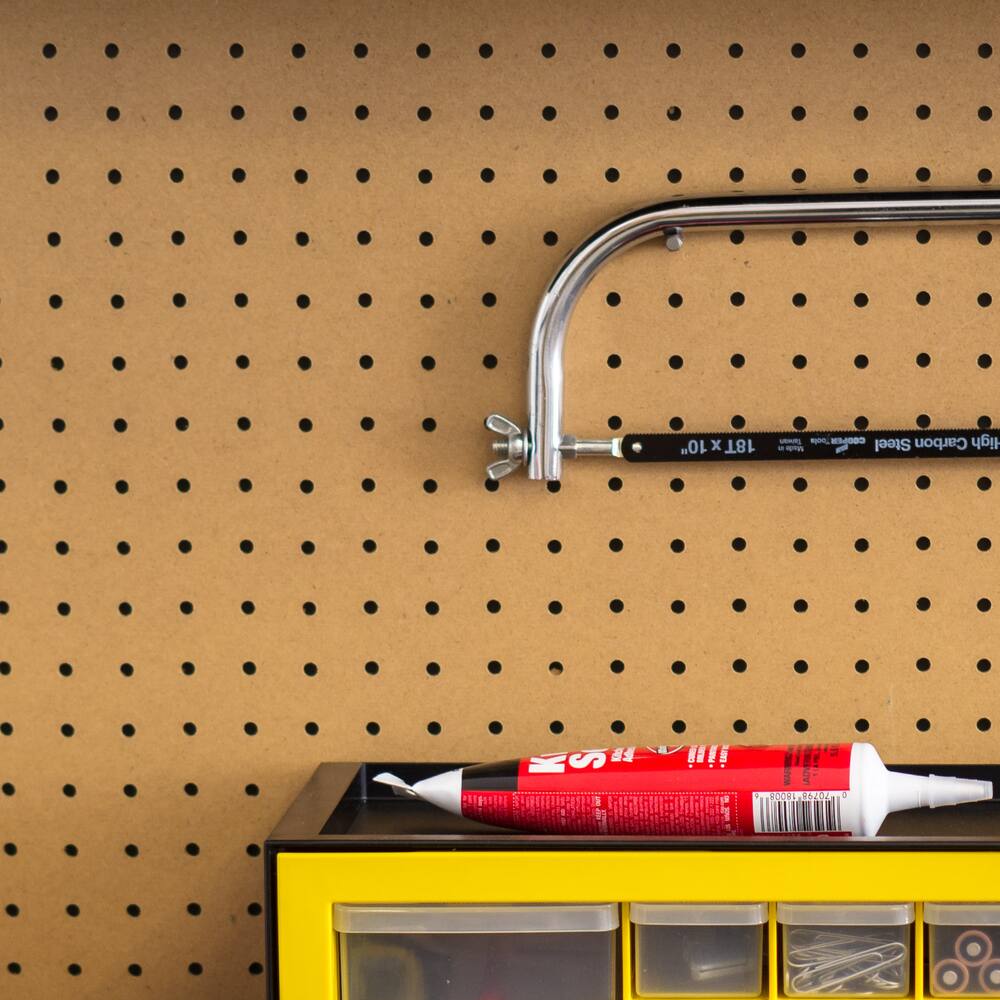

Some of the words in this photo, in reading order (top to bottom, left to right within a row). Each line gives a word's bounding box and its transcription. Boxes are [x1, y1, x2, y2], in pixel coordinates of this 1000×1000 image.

[681, 438, 707, 455] 10"
[711, 439, 722, 451] x
[725, 438, 755, 455] 18T
[831, 437, 865, 445] COOPER
[875, 438, 911, 453] Steel
[915, 436, 967, 452] Carbon
[770, 792, 796, 800] 18008
[802, 792, 830, 800] 70798
